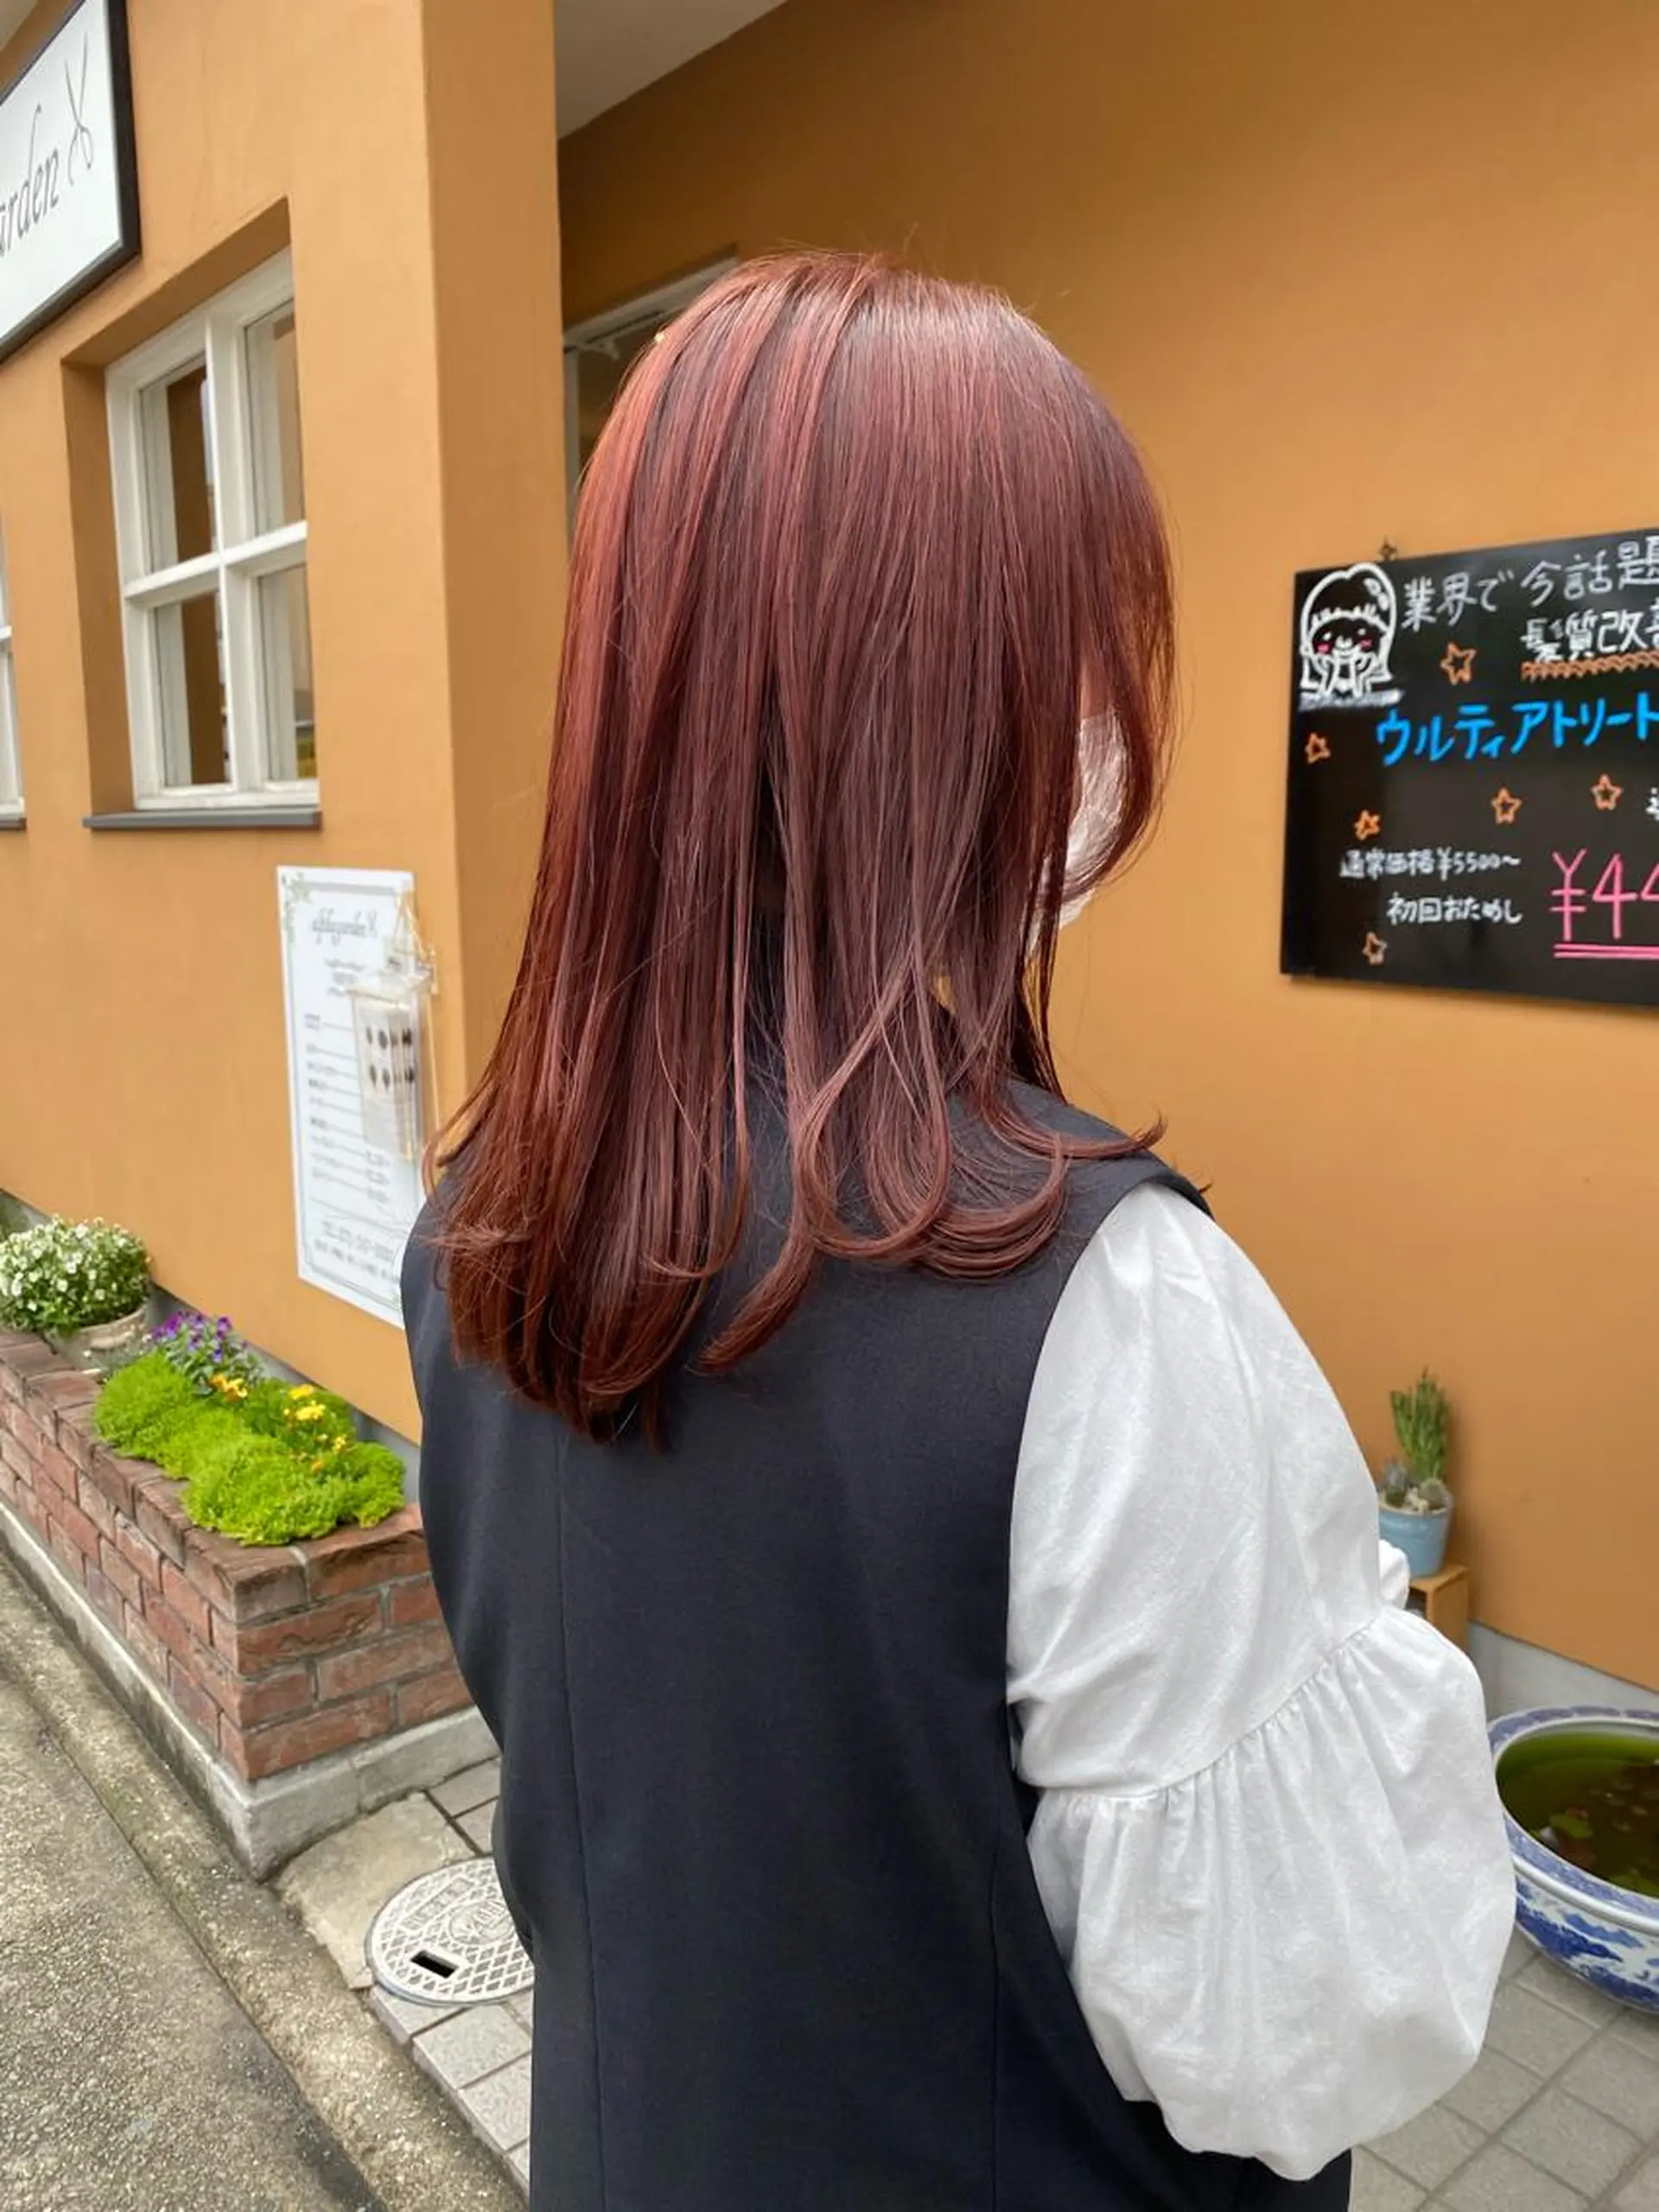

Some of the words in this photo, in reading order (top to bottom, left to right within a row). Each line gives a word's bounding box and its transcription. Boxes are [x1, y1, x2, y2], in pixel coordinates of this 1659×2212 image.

[1386, 891, 1523, 925] 初回おためし
